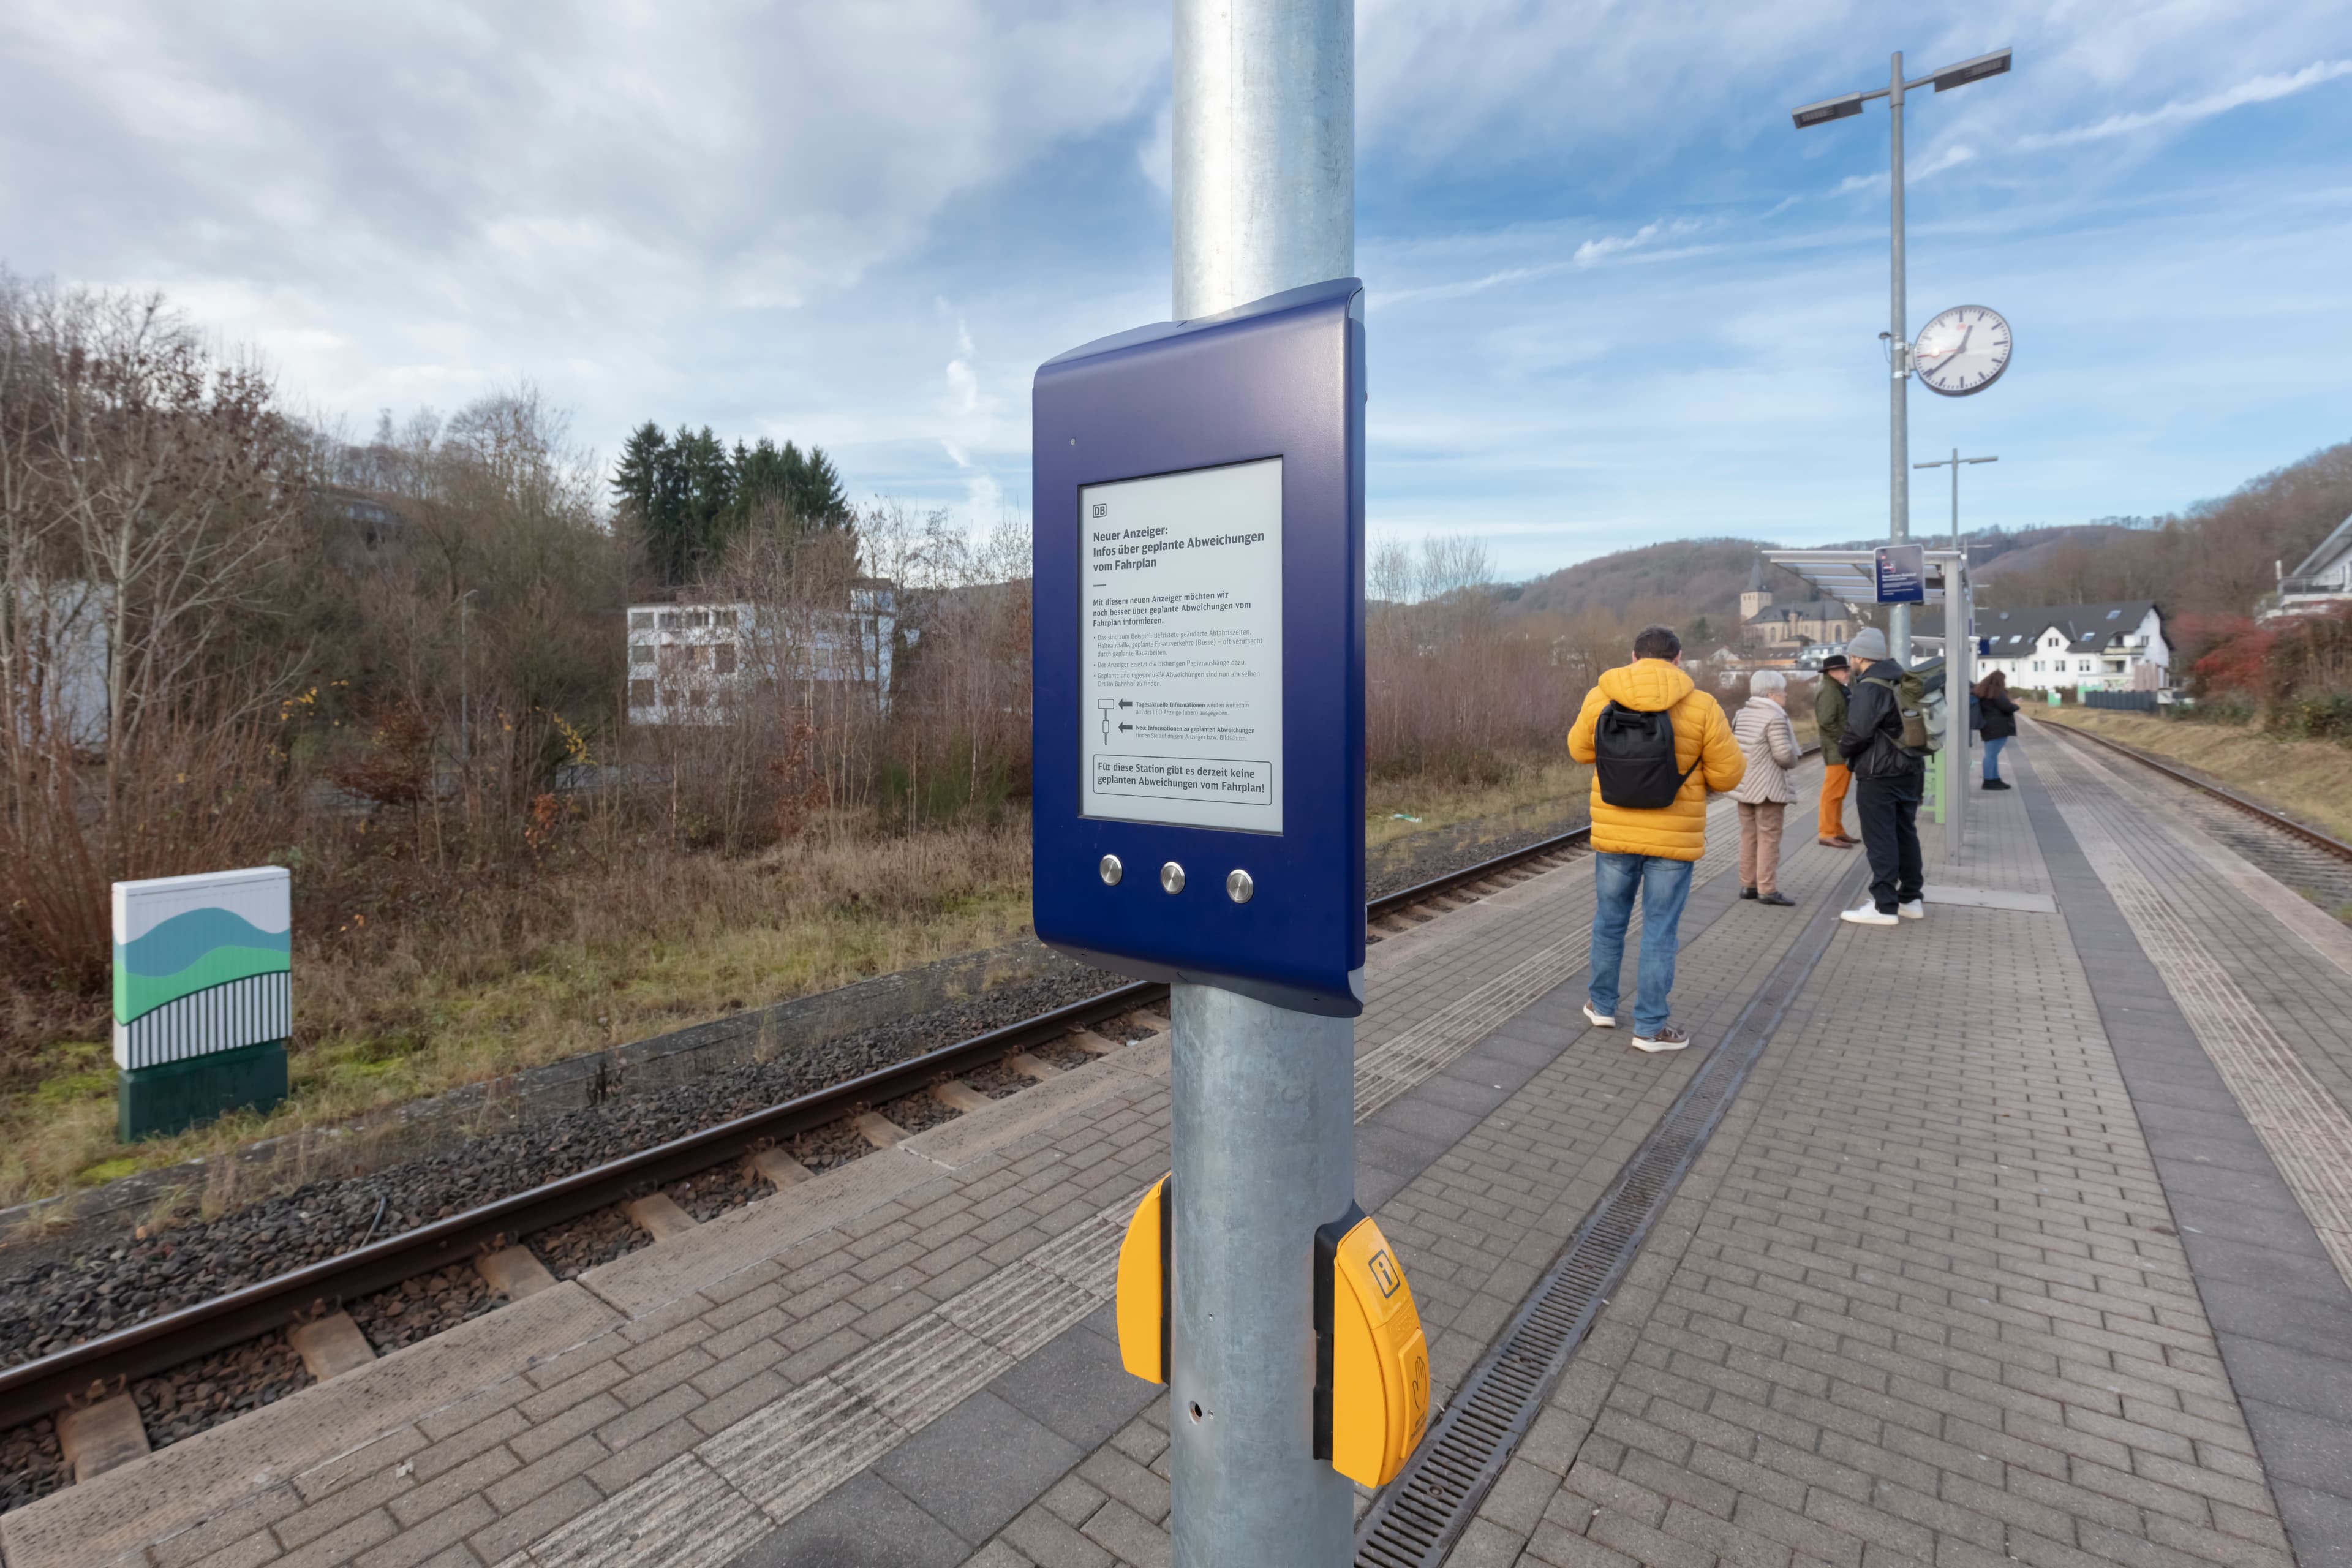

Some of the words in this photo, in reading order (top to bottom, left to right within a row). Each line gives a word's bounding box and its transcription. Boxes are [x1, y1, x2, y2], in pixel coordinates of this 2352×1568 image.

[1095, 506, 1105, 515] DB
[1093, 532, 1121, 542] Neuer
[1123, 526, 1168, 538] Anzeiger:
[1093, 546, 1116, 557] Infos
[1118, 544, 1140, 555] über
[1142, 540, 1185, 555] geplante
[1187, 532, 1264, 548] Abweichungen
[1093, 563, 1113, 571] vom
[1115, 558, 1156, 570] Fahrplan
[1152, 594, 1182, 603] Anzeiger
[1150, 605, 1179, 615] geplante
[1181, 603, 1233, 612] Abweichungen
[1093, 619, 1121, 627] Fahrplan
[1123, 617, 1164, 625] informieren.
[1155, 638, 1194, 647] Ersatzverkehre
[1098, 762, 1111, 771] Für
[1113, 763, 1133, 772] diese
[1136, 764, 1164, 774] Station
[1166, 766, 1183, 776] gibt
[1197, 767, 1227, 777] derzeit
[1231, 768, 1255, 778] keine
[1098, 775, 1136, 785] geplanten
[1139, 777, 1198, 790] Abweichungen
[1200, 782, 1219, 790] vom
[1221, 781, 1264, 793] Fahrplan!
